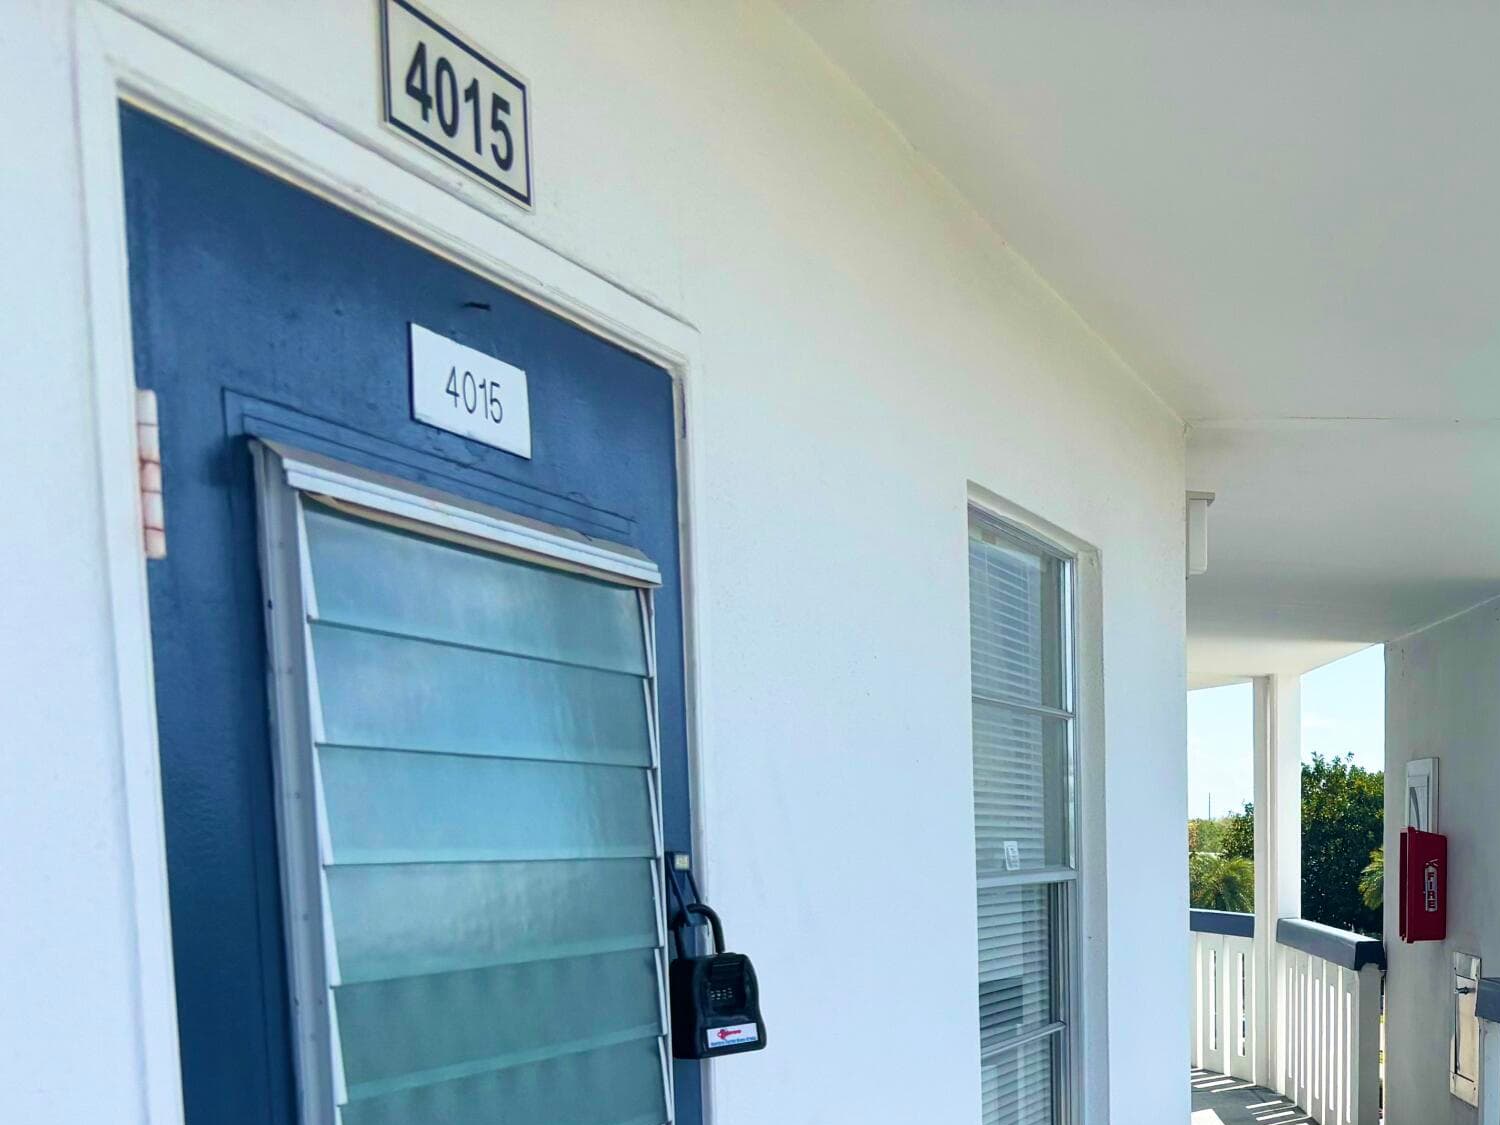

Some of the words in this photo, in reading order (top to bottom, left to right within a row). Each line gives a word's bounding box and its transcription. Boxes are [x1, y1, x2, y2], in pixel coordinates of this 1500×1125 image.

[405, 41, 514, 172] 4015
[445, 366, 503, 424] 4015
[1427, 871, 1436, 909] FIRE
